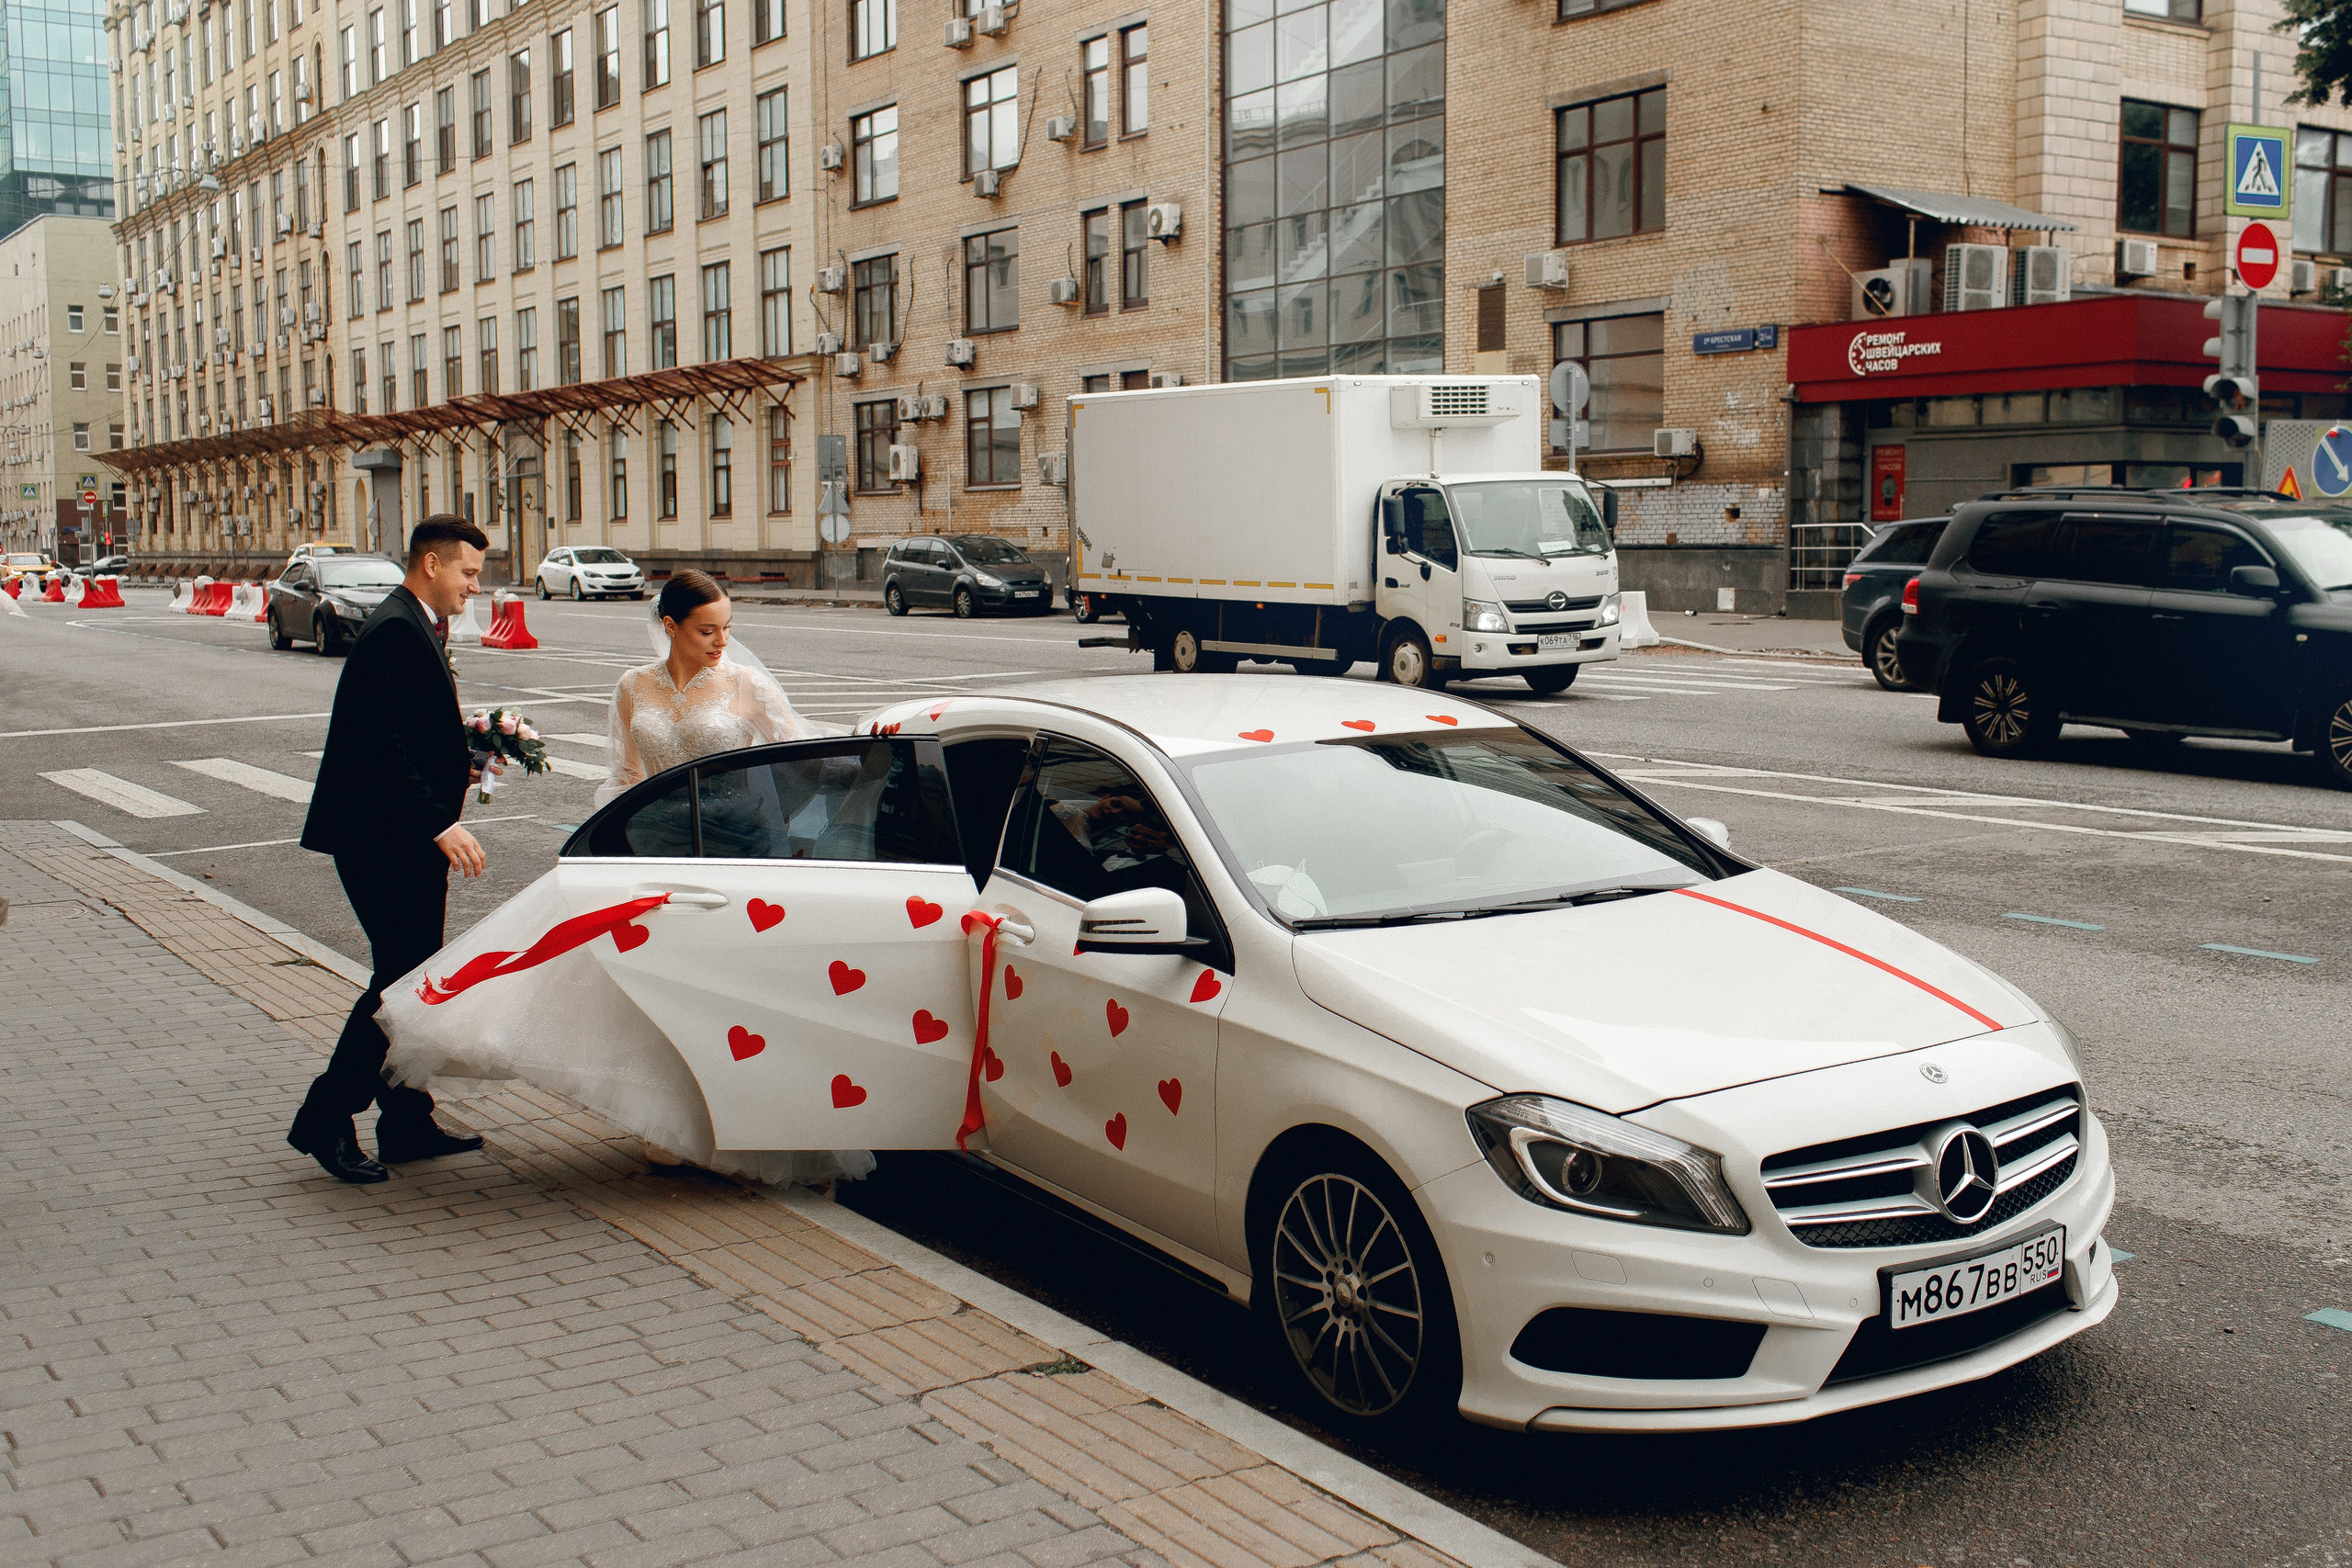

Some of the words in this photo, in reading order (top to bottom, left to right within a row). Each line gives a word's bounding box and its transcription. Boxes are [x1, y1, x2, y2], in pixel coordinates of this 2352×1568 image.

[1866, 332, 1906, 346] РЕМОНТ
[1865, 342, 1941, 359] ШВЕЙЦАРСКИХ
[1865, 359, 1898, 372] ЧАСОВ
[1901, 1262, 2018, 1321] М867ВВ
[2022, 1236, 2057, 1274] 550
[2030, 1270, 2047, 1285] RUS
